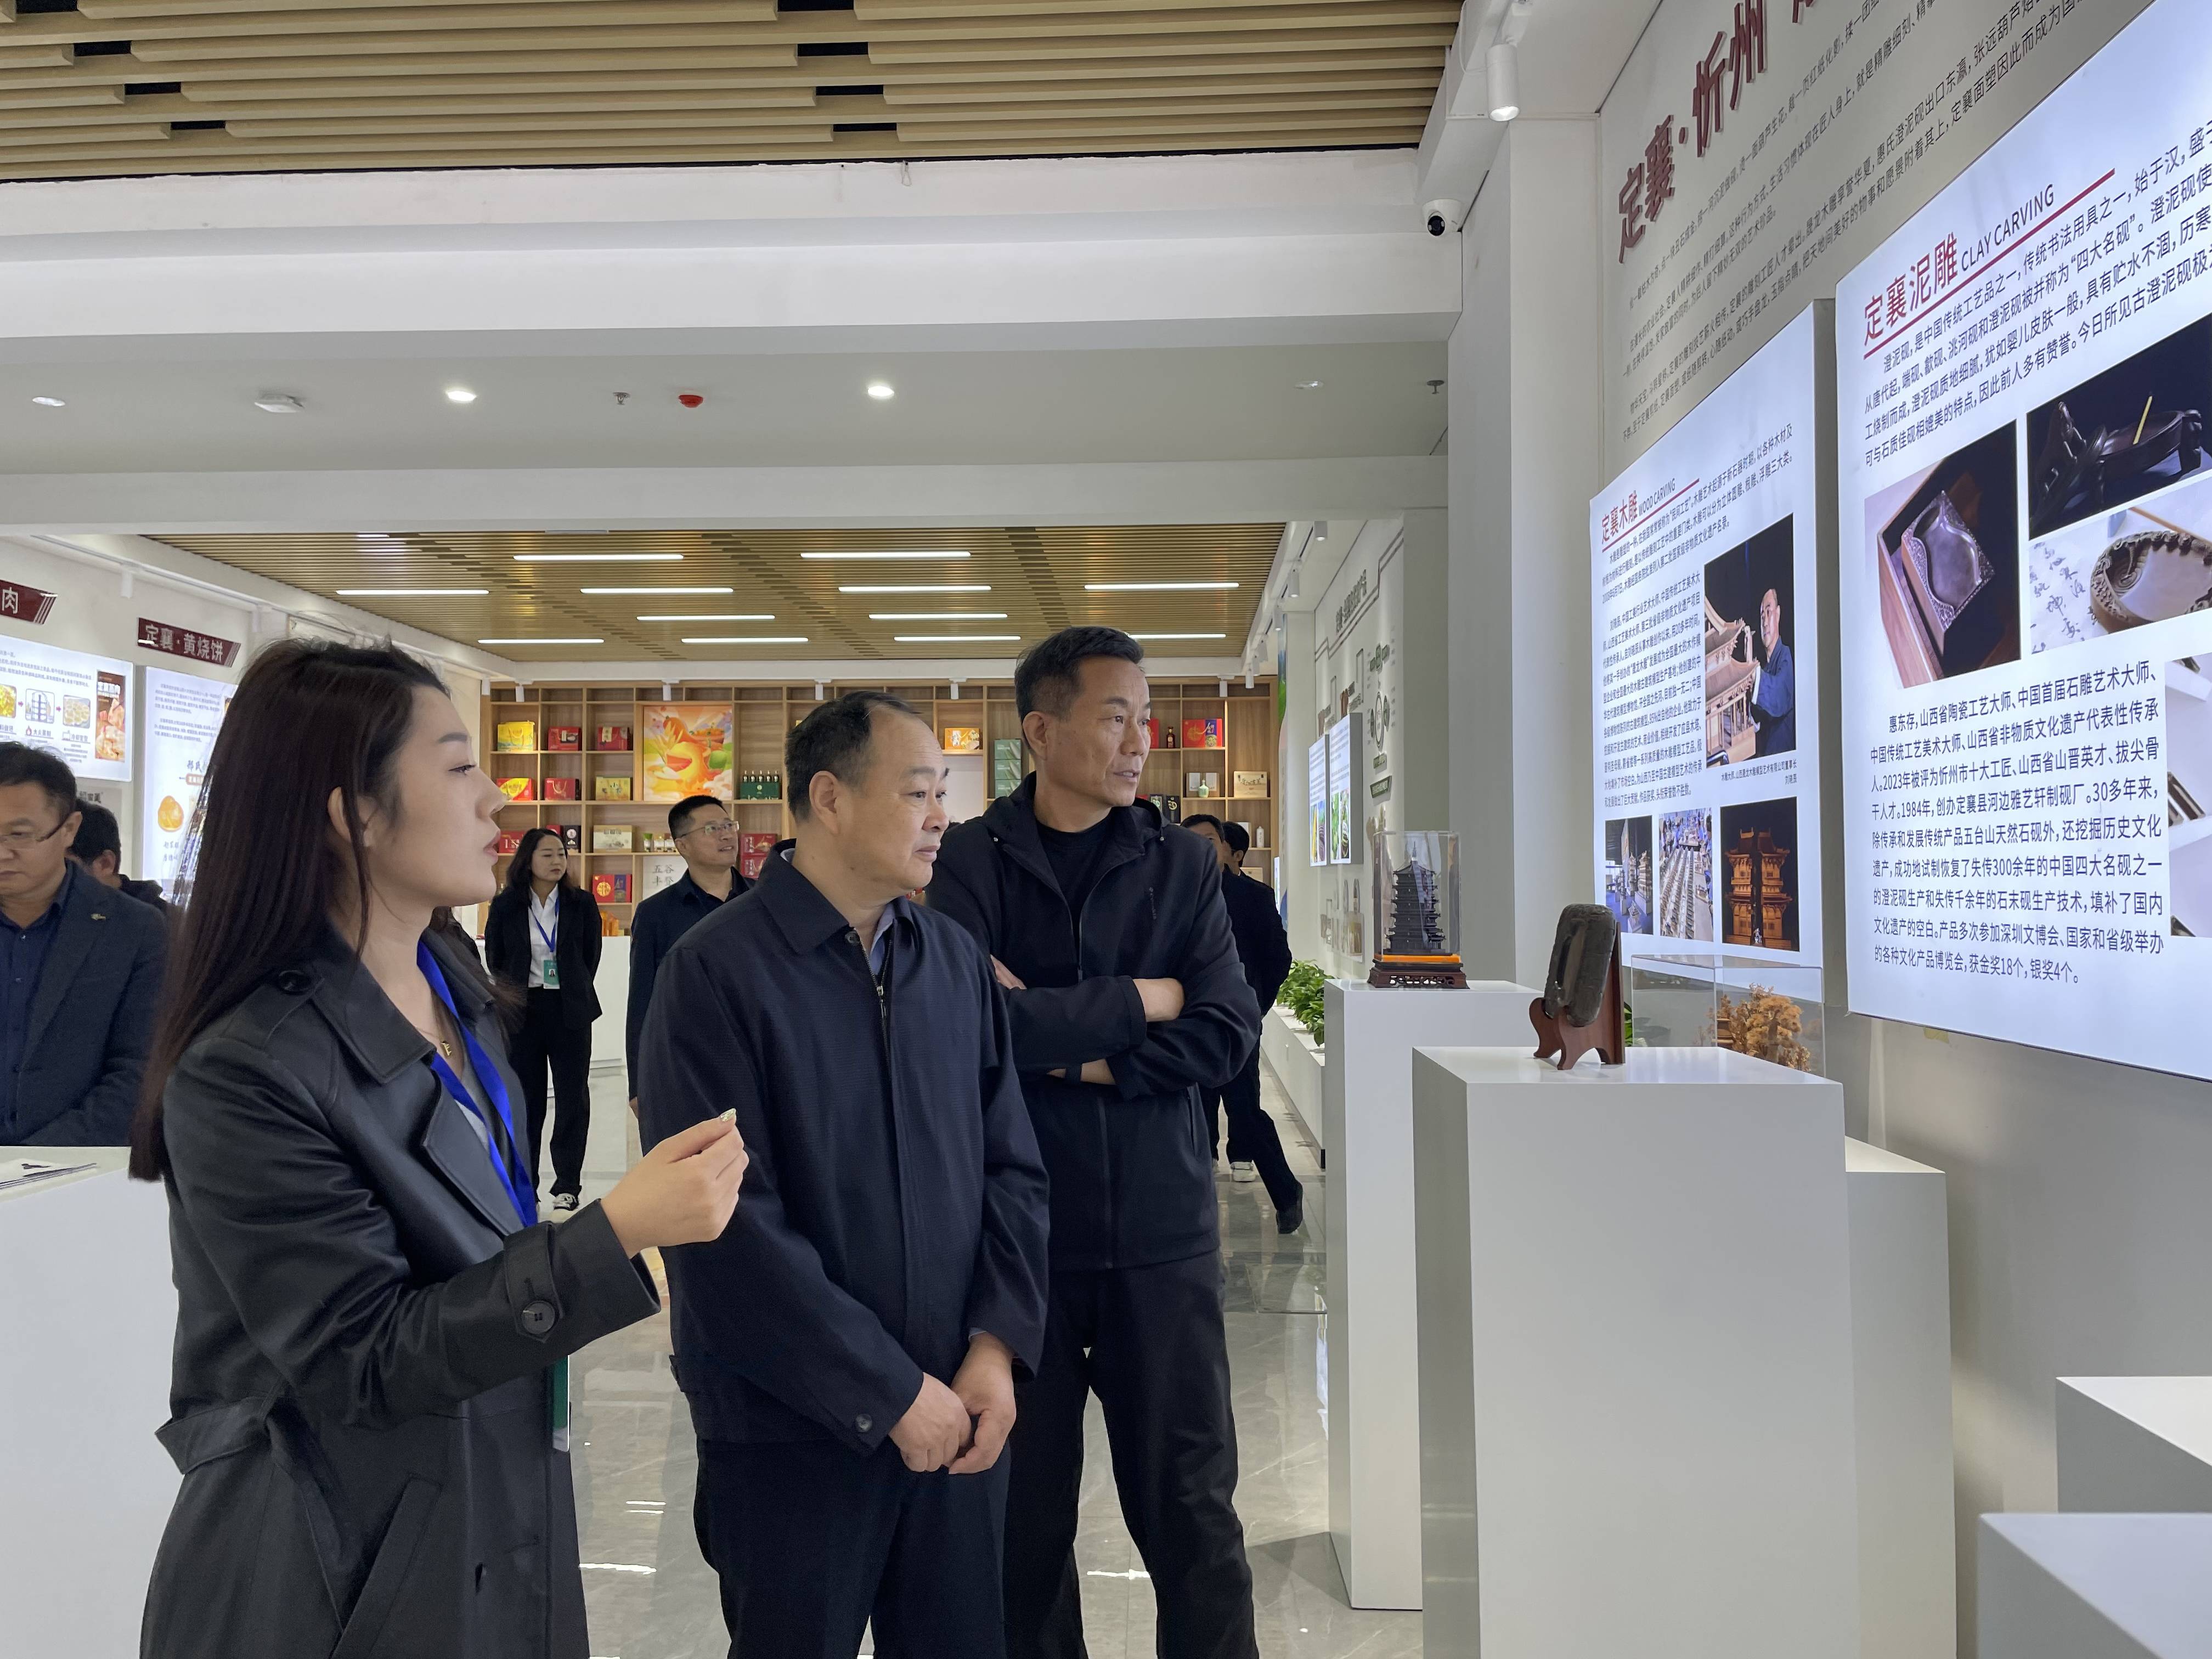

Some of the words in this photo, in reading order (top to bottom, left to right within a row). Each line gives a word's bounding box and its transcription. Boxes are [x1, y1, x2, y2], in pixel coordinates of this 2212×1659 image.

[1962, 232, 1991, 271] CLAY
[1995, 184, 2055, 245] CARVING
[1864, 232, 1958, 346] 定襄泥雕
[1602, 489, 1637, 544] 定襄木雕
[1638, 496, 1653, 517] WOOD
[1654, 478, 1675, 505] CARVING
[1, 586, 19, 614] 肉
